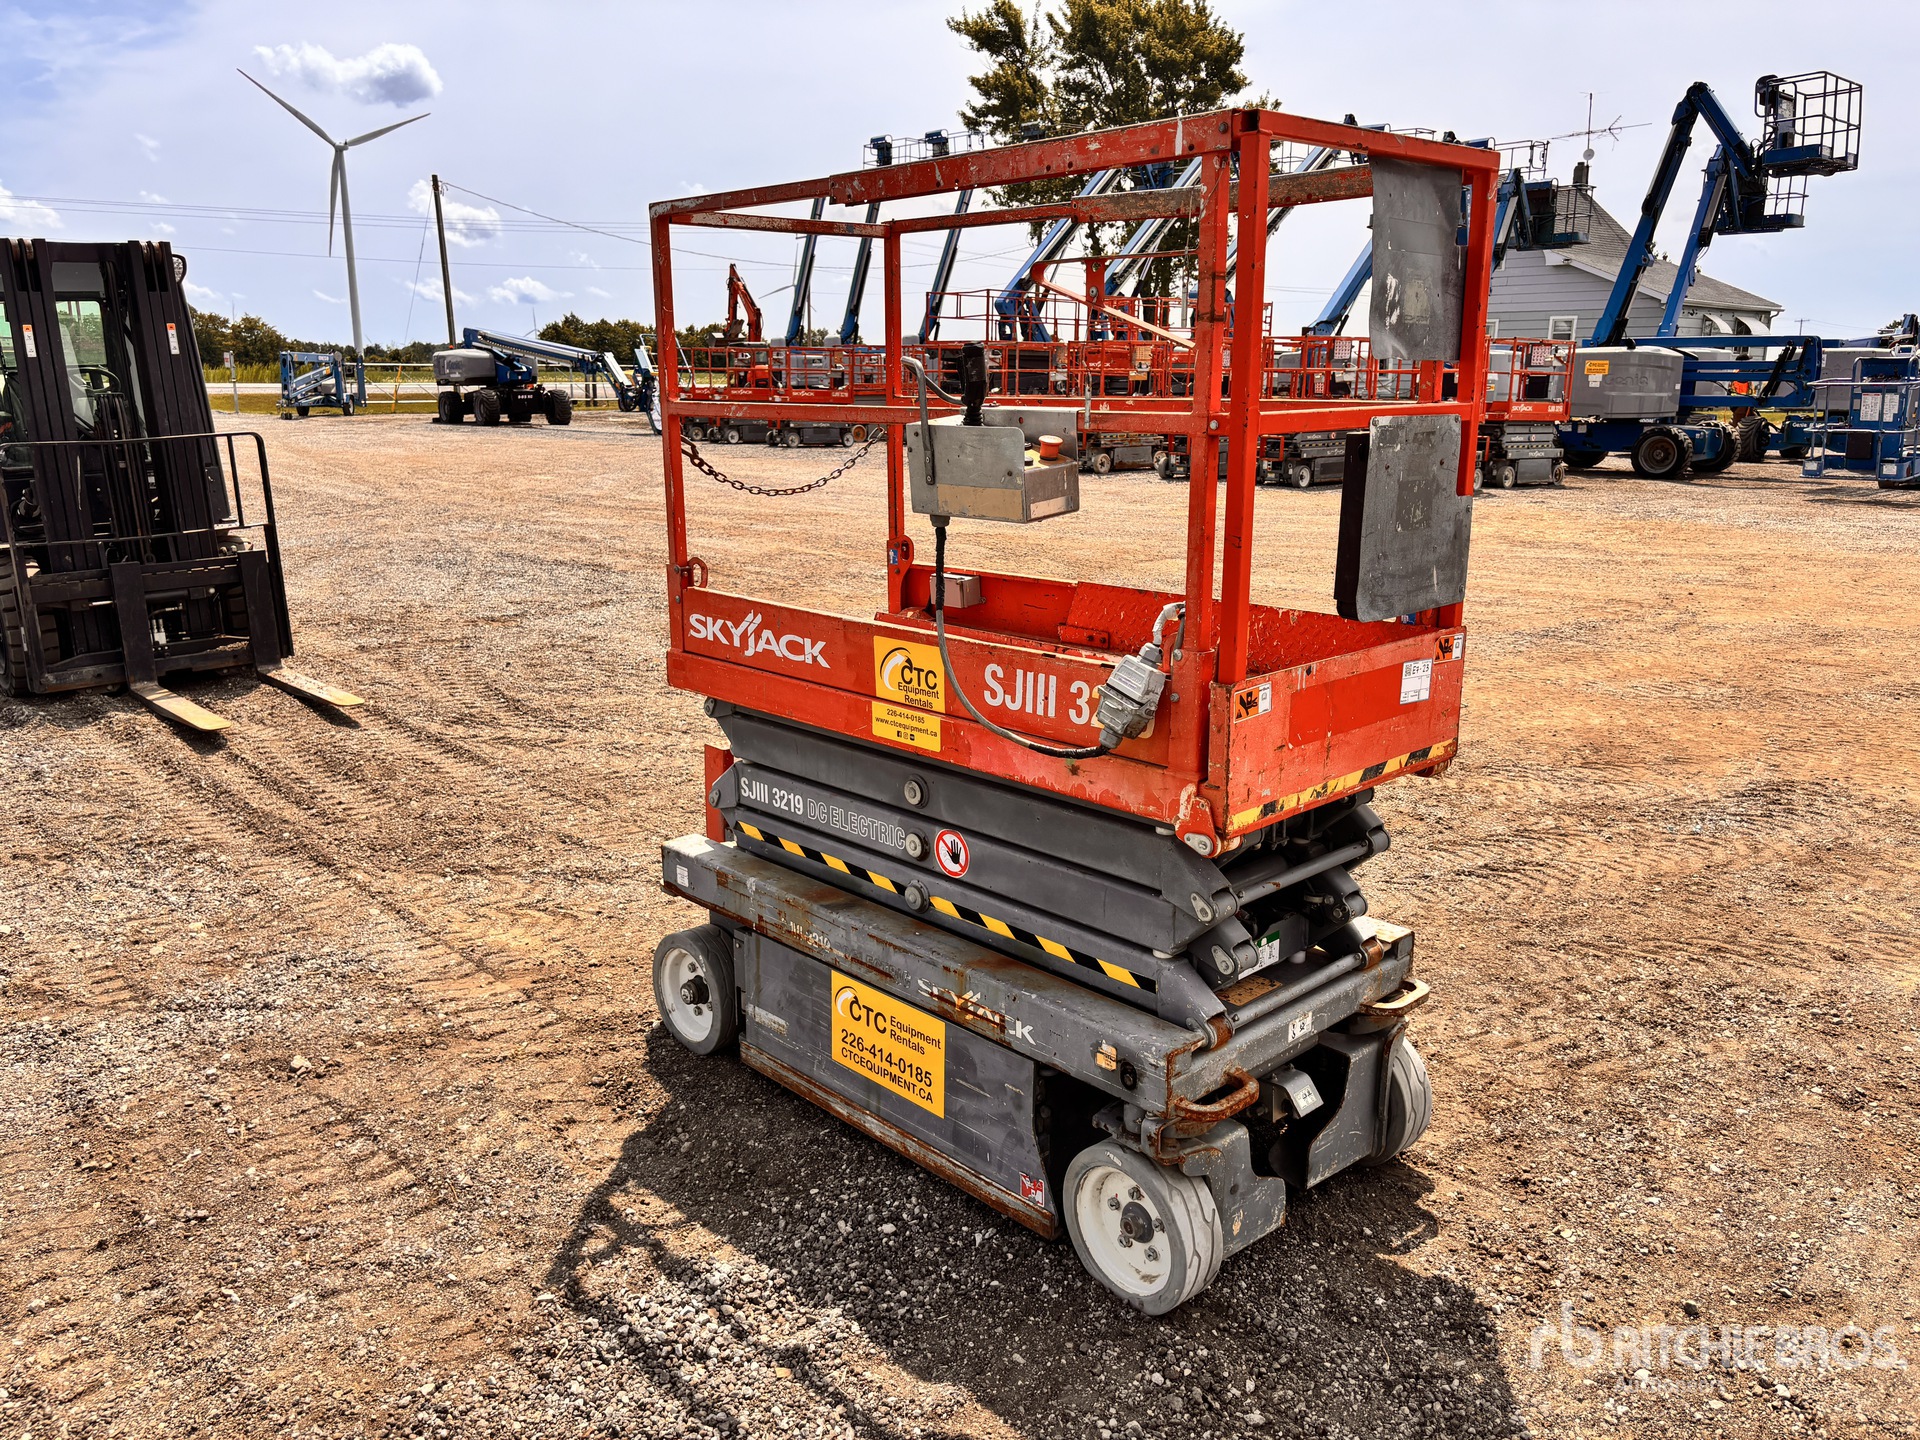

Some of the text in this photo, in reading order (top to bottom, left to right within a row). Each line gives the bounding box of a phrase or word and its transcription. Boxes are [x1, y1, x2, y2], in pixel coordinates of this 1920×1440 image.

[1604, 373, 1649, 387] Genie
[1512, 403, 1533, 412] SKYJACK
[688, 609, 831, 669] SKYJACK
[900, 665, 937, 690] CTC
[897, 682, 940, 699] Equipment
[904, 694, 933, 709] Rentals
[875, 717, 938, 737] www.ctcequipment.ca
[886, 708, 925, 724] 226-414-0185
[740, 776, 906, 850] SJIII 3219 DC ELECTRIC
[849, 999, 887, 1035] CTC
[890, 1015, 941, 1050] Equipment
[890, 1030, 925, 1055] Rentals
[841, 1028, 932, 1088] 226-414-0185
[841, 1046, 934, 1104] CTCEQUIPMENT.CA
